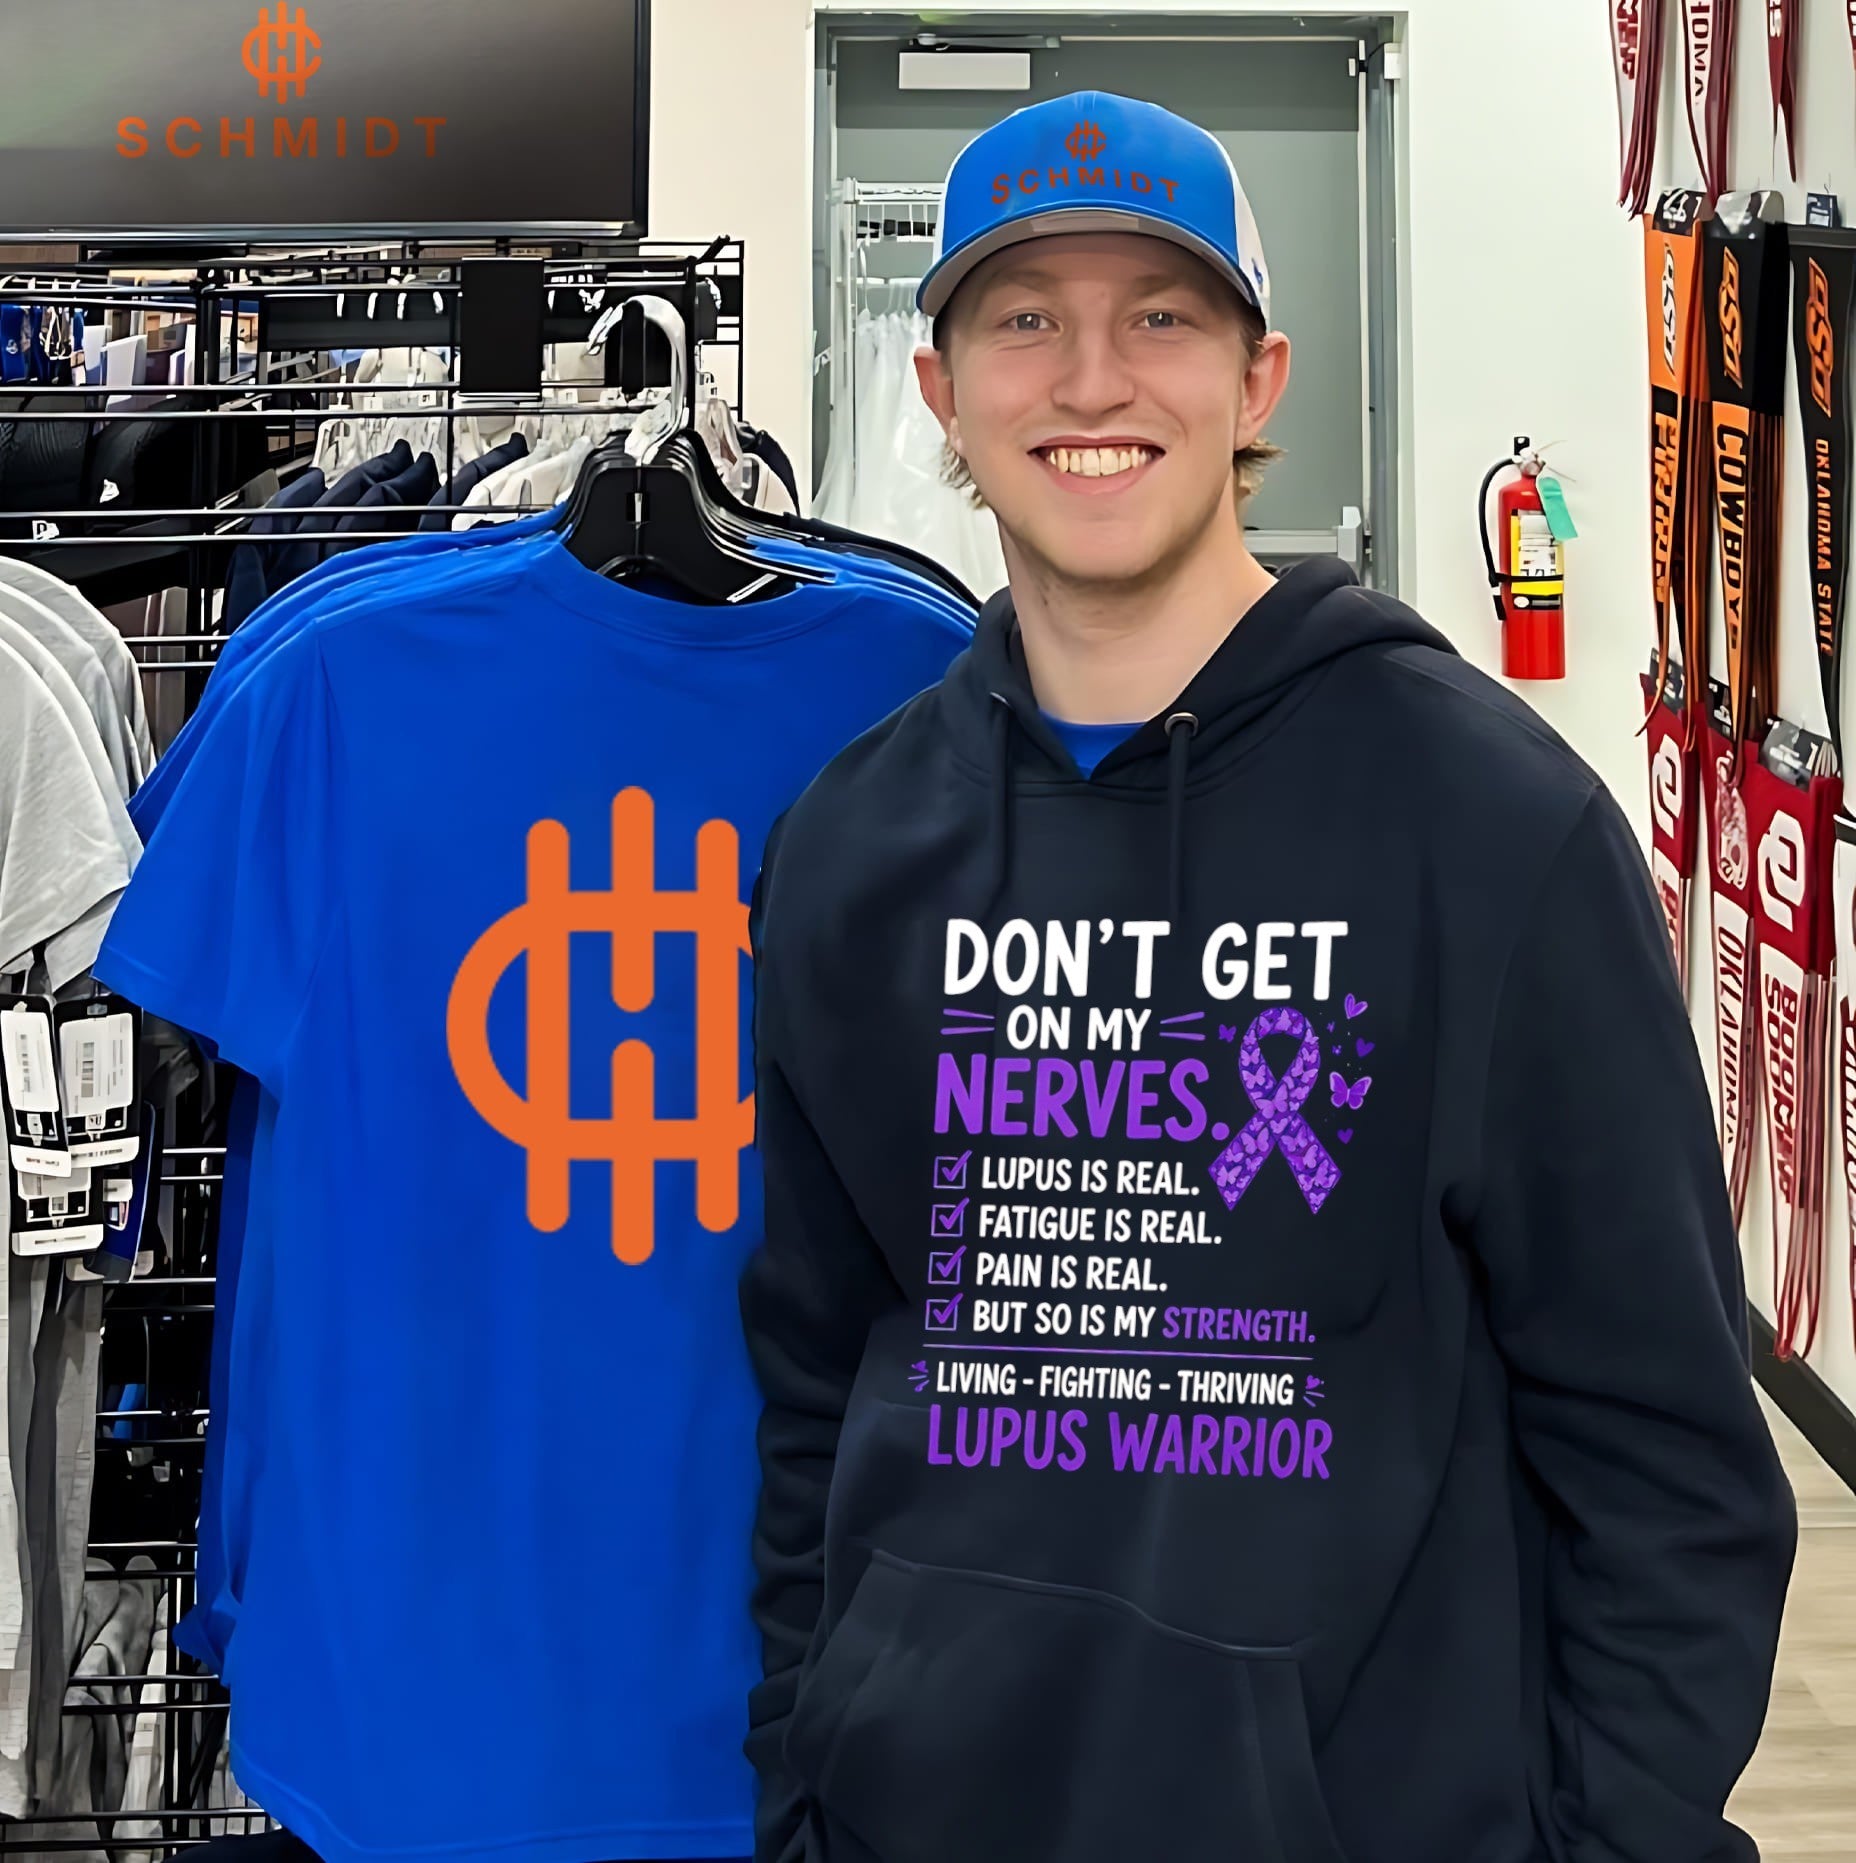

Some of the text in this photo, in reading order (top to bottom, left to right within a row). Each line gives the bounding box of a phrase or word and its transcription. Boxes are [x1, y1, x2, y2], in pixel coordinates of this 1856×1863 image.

[116, 116, 447, 159] SCHMIDT
[991, 166, 1180, 205] SCHMIDT
[1815, 438, 1832, 570] OKLAHOMA
[1201, 920, 1349, 1001] GET
[1006, 1003, 1152, 1052] ON MY
[1718, 924, 1745, 1144] OKLAHOMA
[933, 1052, 1230, 1142] NERVES.
[981, 1155, 1200, 1196] LUPUS IS REAL.
[978, 1204, 1222, 1245] FATIGUE IS REAL.
[975, 1251, 1168, 1292] PAIN IS REAL.
[972, 1299, 1316, 1343] BUT SO IS MY STRENGTH.
[936, 1360, 1017, 1396] LIVING
[1039, 1365, 1152, 1401] FIGHTING
[1177, 1369, 1295, 1406] THRIVING
[927, 1403, 1333, 1480] LUPUS WARRIOR
